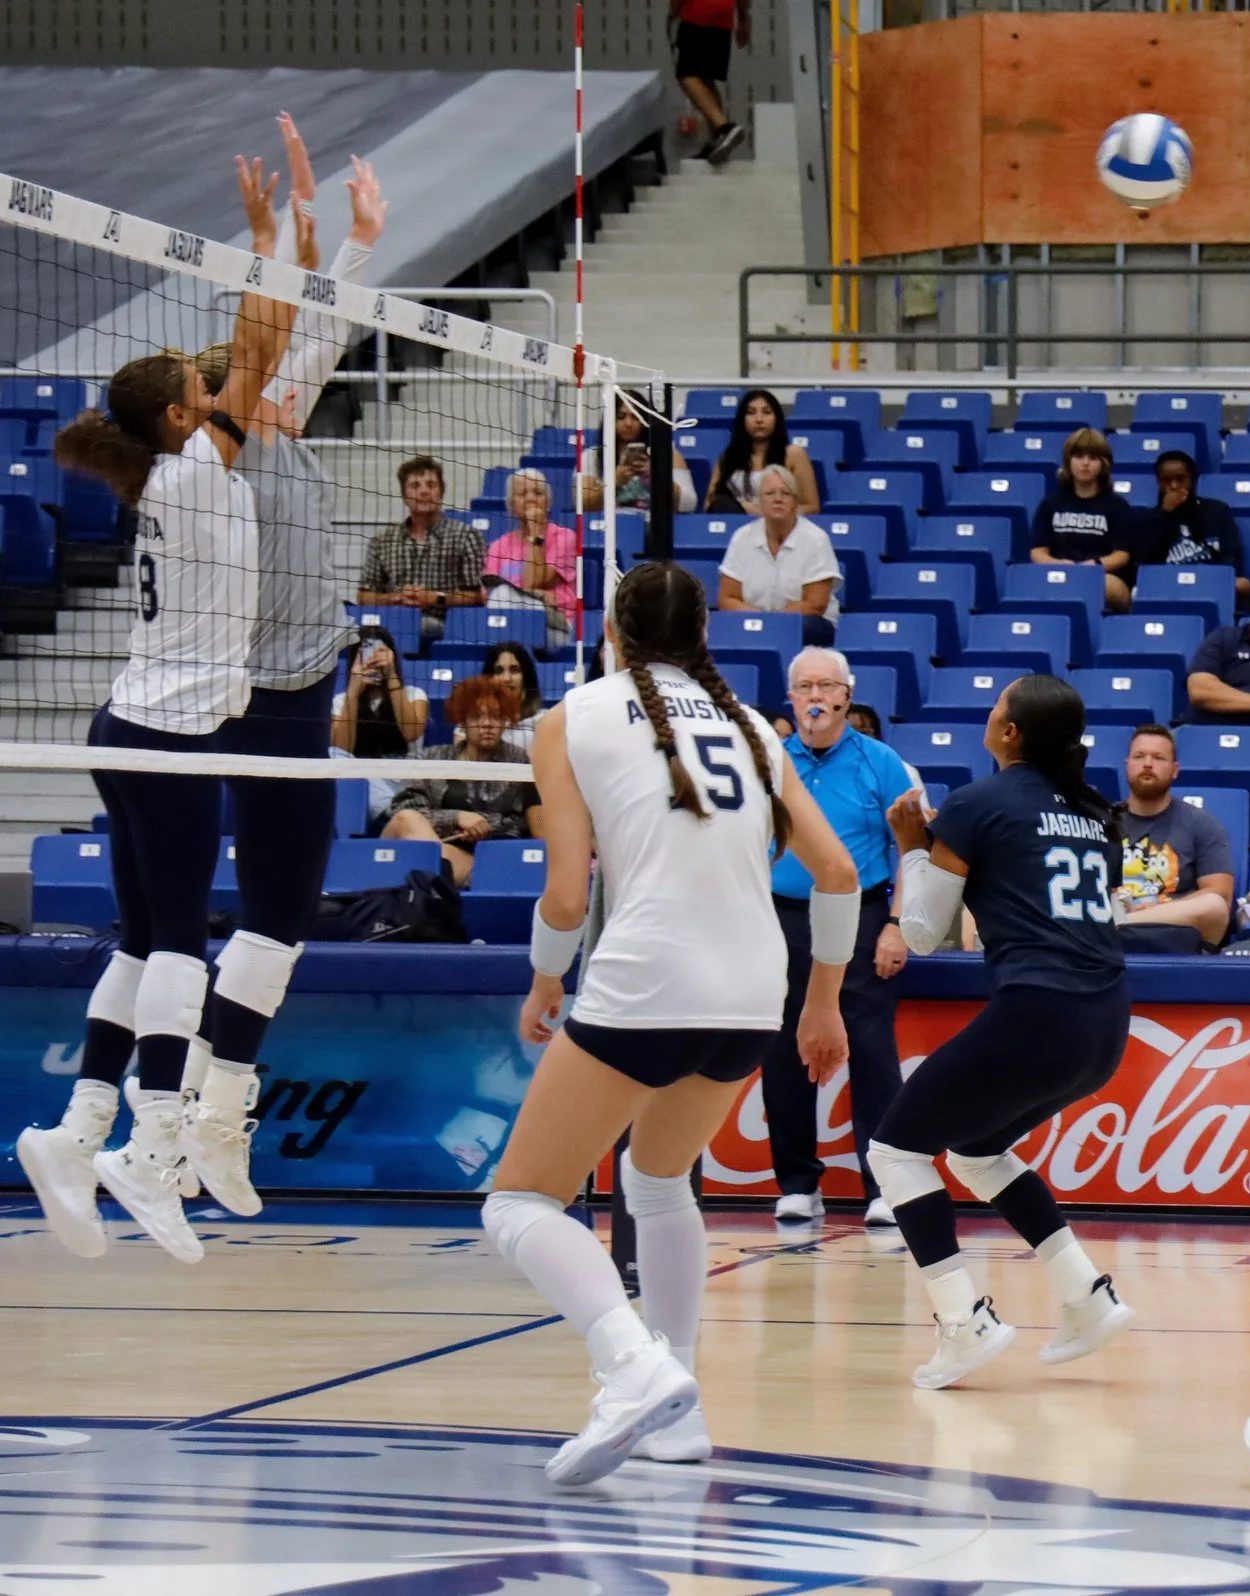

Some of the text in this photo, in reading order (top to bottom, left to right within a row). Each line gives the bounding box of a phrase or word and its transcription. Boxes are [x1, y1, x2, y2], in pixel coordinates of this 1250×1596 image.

[1052, 511, 1109, 533] AUGUSTA
[626, 695, 734, 725] AGUST
[1045, 847, 1114, 924] 23
[250, 1063, 371, 1160] ing
